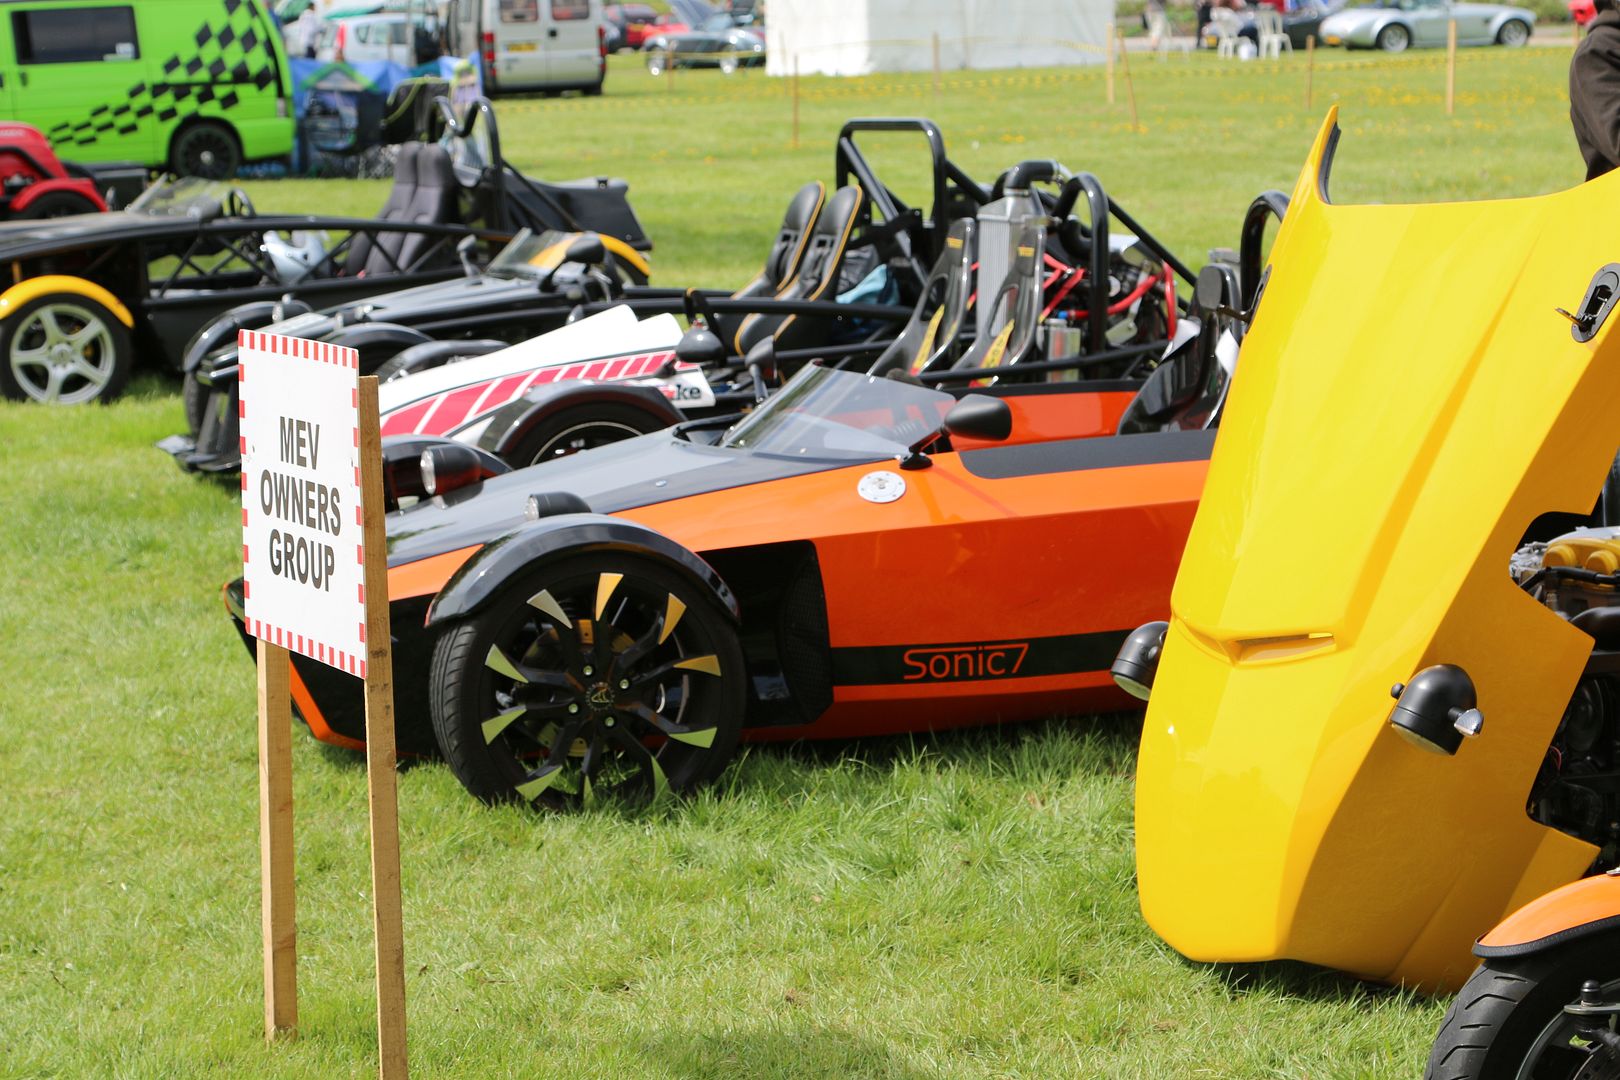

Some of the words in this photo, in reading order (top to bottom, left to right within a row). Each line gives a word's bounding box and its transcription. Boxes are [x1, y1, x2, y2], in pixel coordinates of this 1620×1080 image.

[279, 416, 320, 470] MEV
[260, 469, 341, 537] OWNERS
[269, 528, 335, 592] GROUP
[903, 643, 1029, 680] Sonic7
